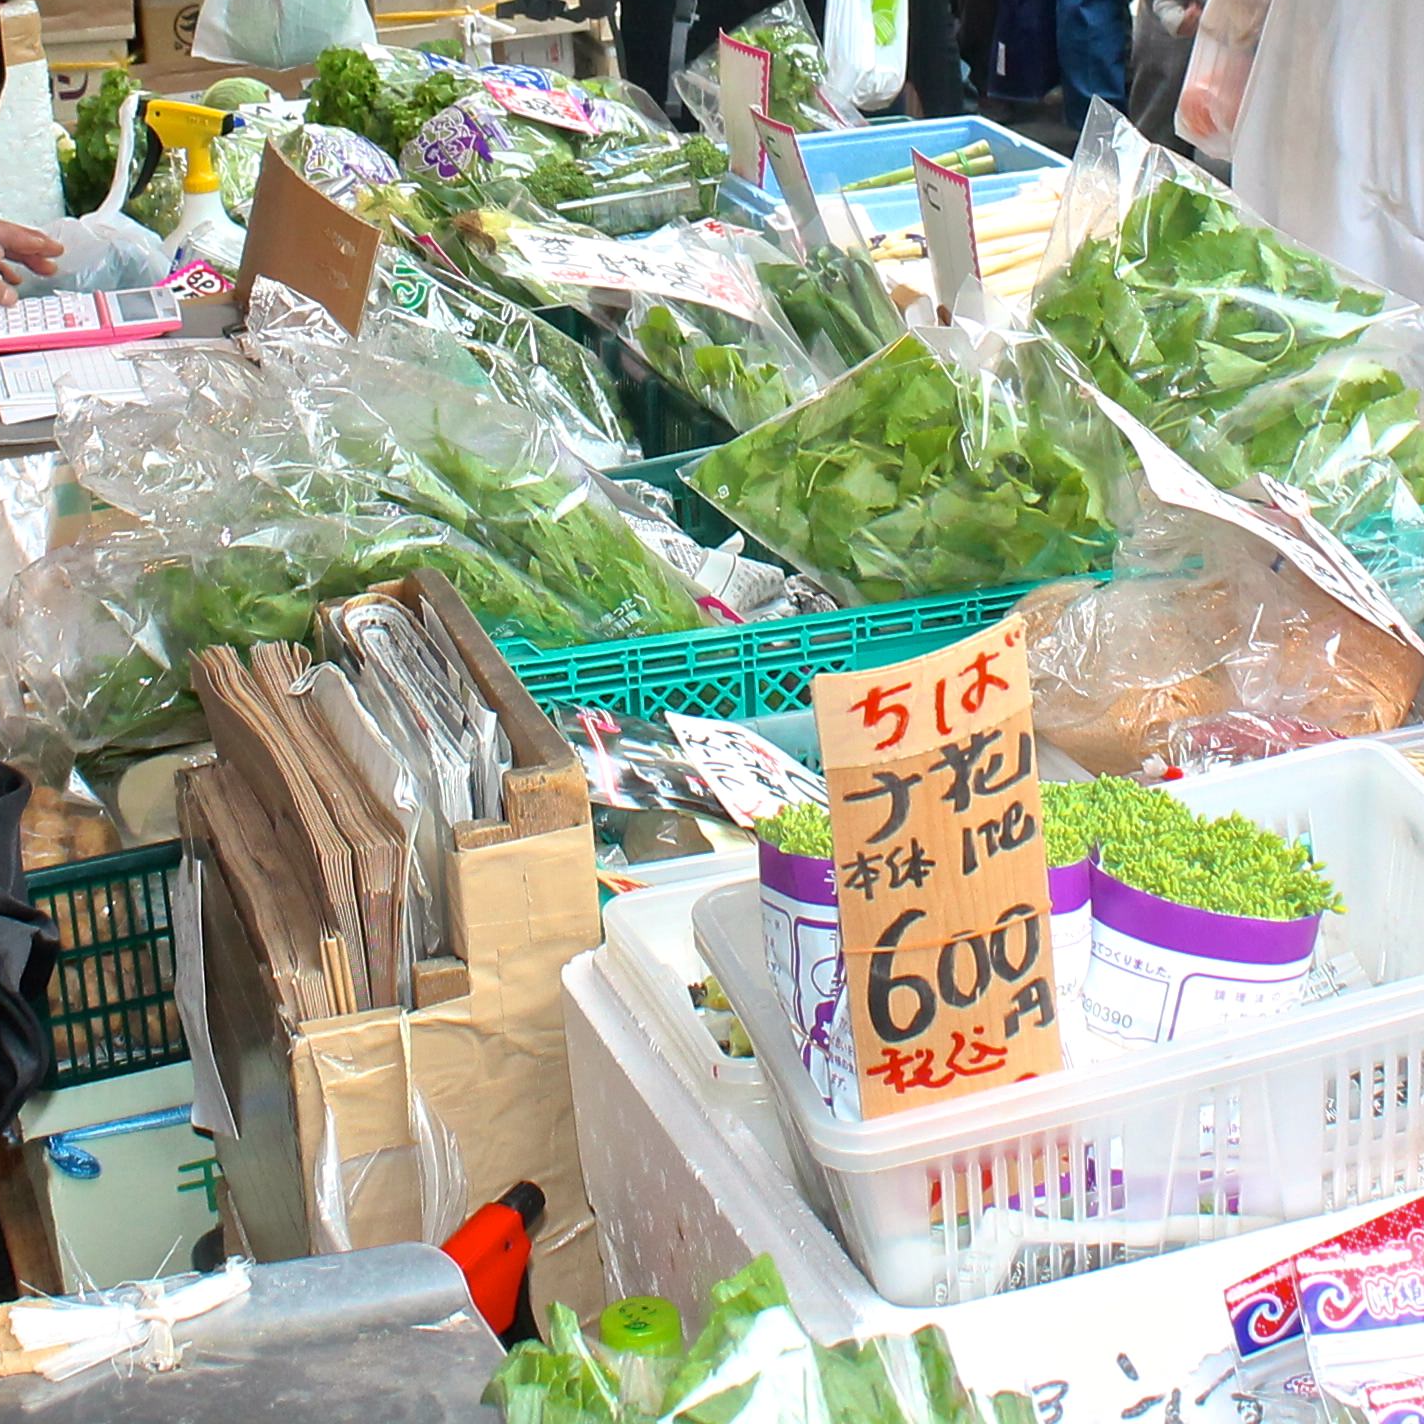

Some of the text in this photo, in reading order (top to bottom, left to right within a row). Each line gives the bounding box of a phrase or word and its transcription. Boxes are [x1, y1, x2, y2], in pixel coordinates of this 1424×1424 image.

[848, 629, 1022, 750] ちば
[842, 728, 1034, 844] ナ花
[842, 837, 936, 901] 本体
[867, 902, 1057, 1044] 600円
[866, 1026, 1010, 1094] 税込
